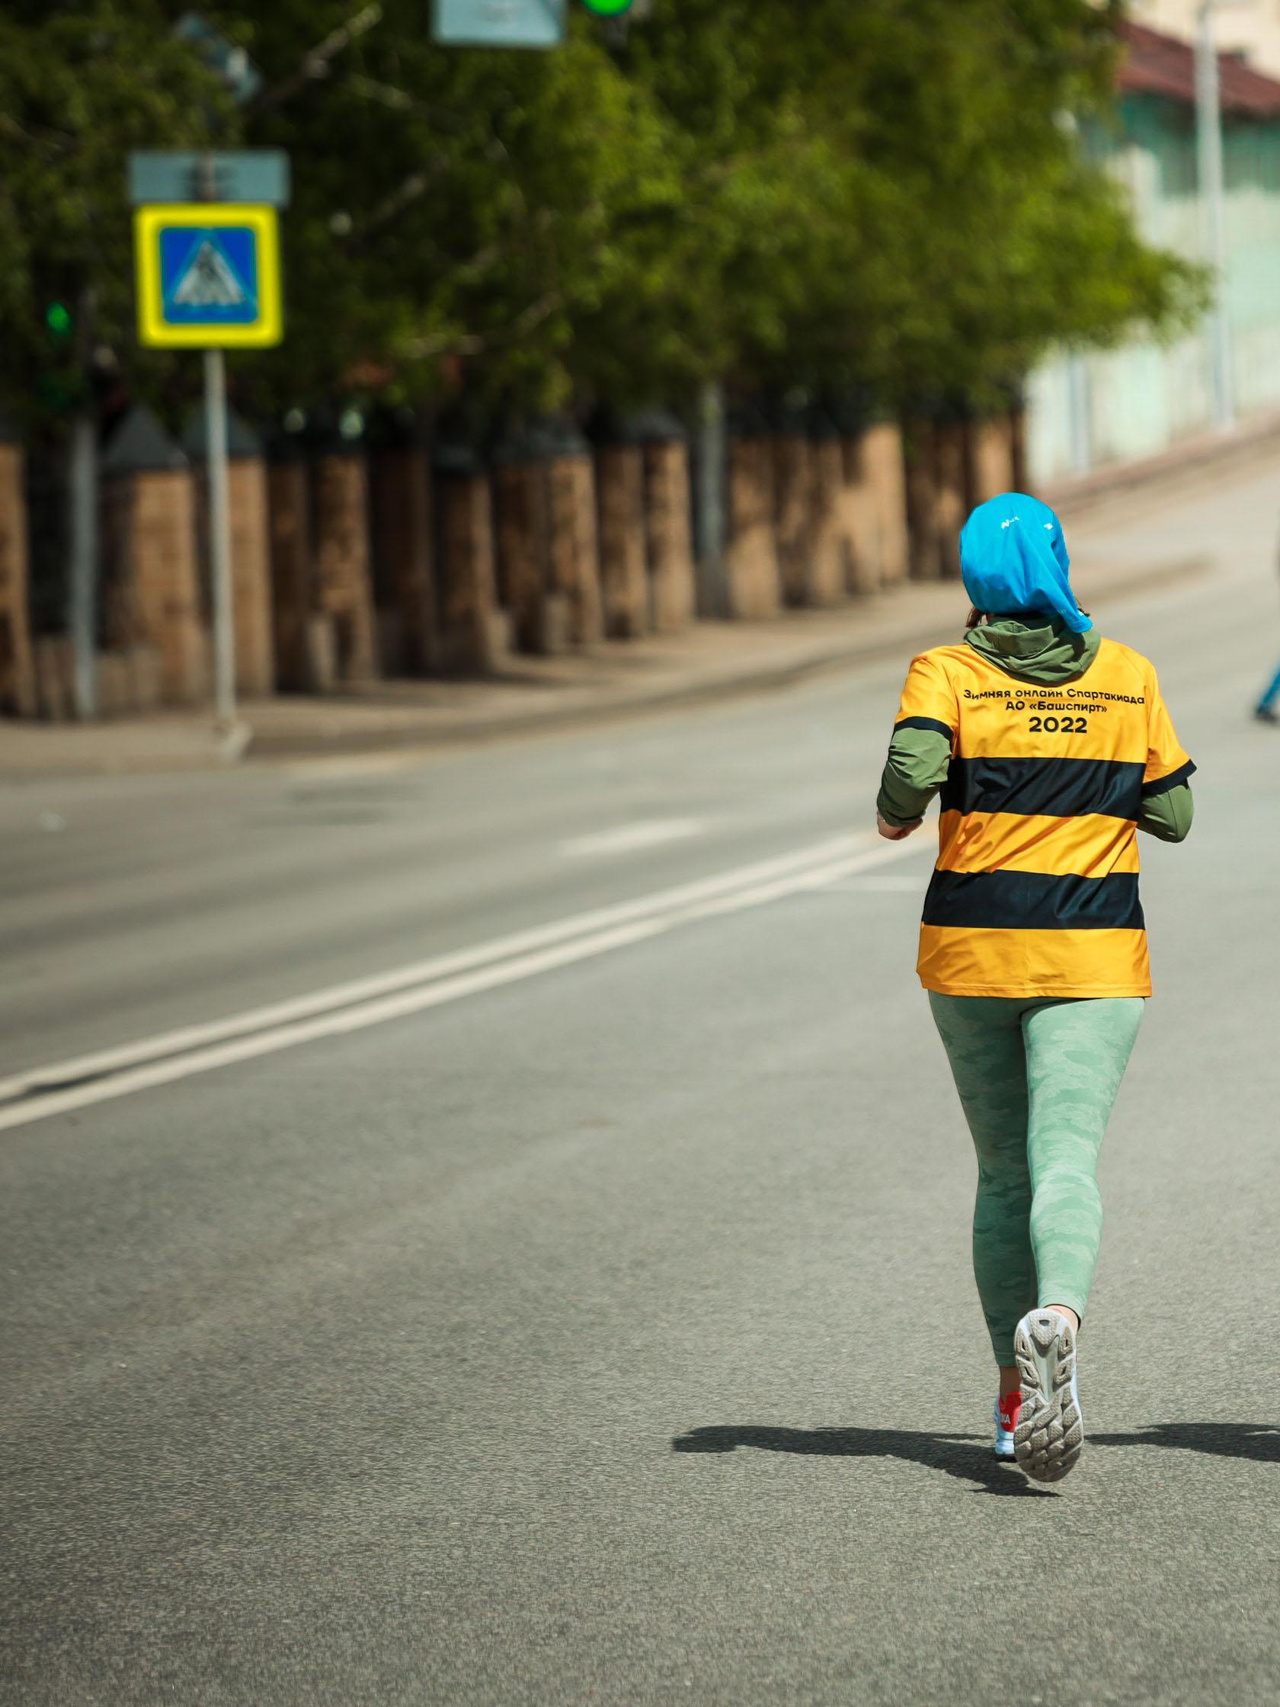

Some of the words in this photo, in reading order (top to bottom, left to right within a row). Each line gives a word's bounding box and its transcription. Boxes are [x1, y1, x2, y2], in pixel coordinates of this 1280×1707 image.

[963, 689, 1011, 700] Зимняя
[1015, 689, 1064, 698] онлайн
[1066, 688, 1145, 705] Спартакиада
[1005, 700, 1026, 711] АО
[1029, 700, 1108, 714] «Башспирт»
[1028, 716, 1088, 734] 2022
